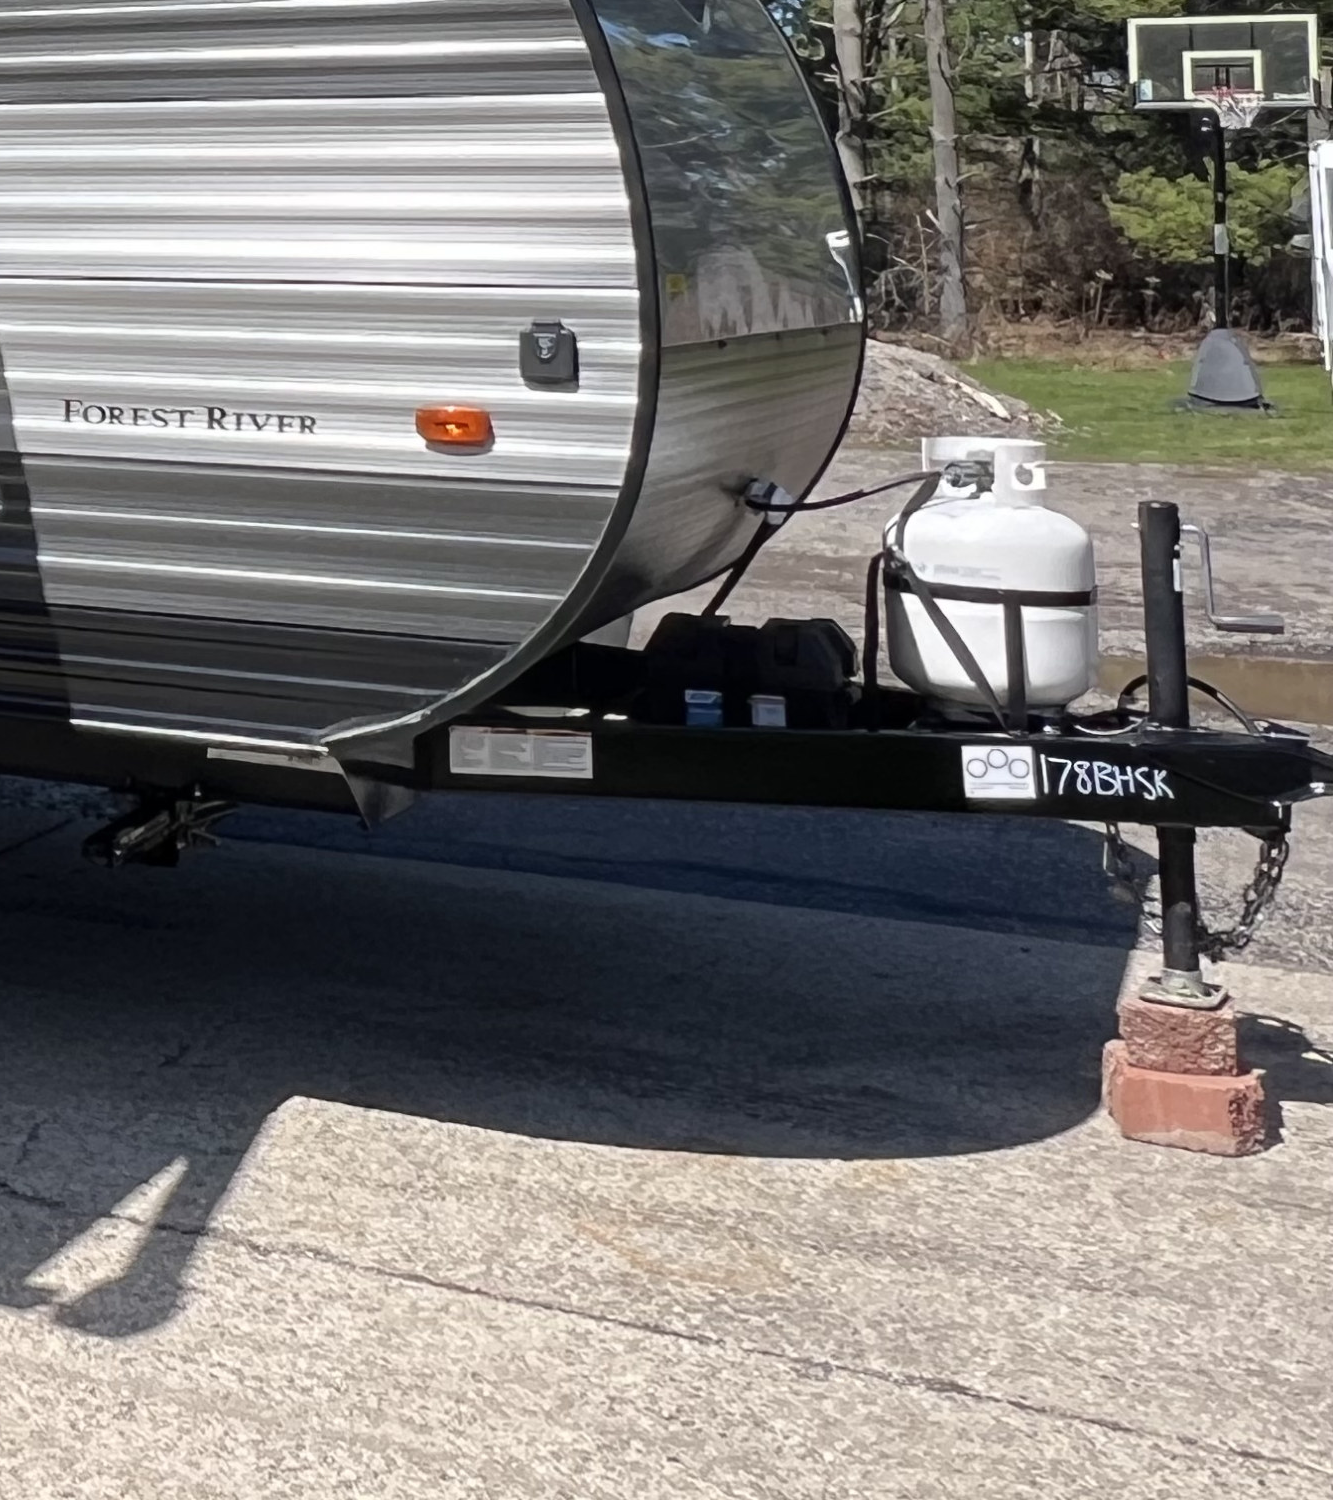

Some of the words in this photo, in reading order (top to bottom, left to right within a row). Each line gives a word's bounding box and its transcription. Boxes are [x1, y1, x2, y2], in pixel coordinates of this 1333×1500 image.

[63, 398, 194, 428] FOREST
[204, 405, 318, 435] RIVER
[1039, 753, 1175, 801] 178BHSK
